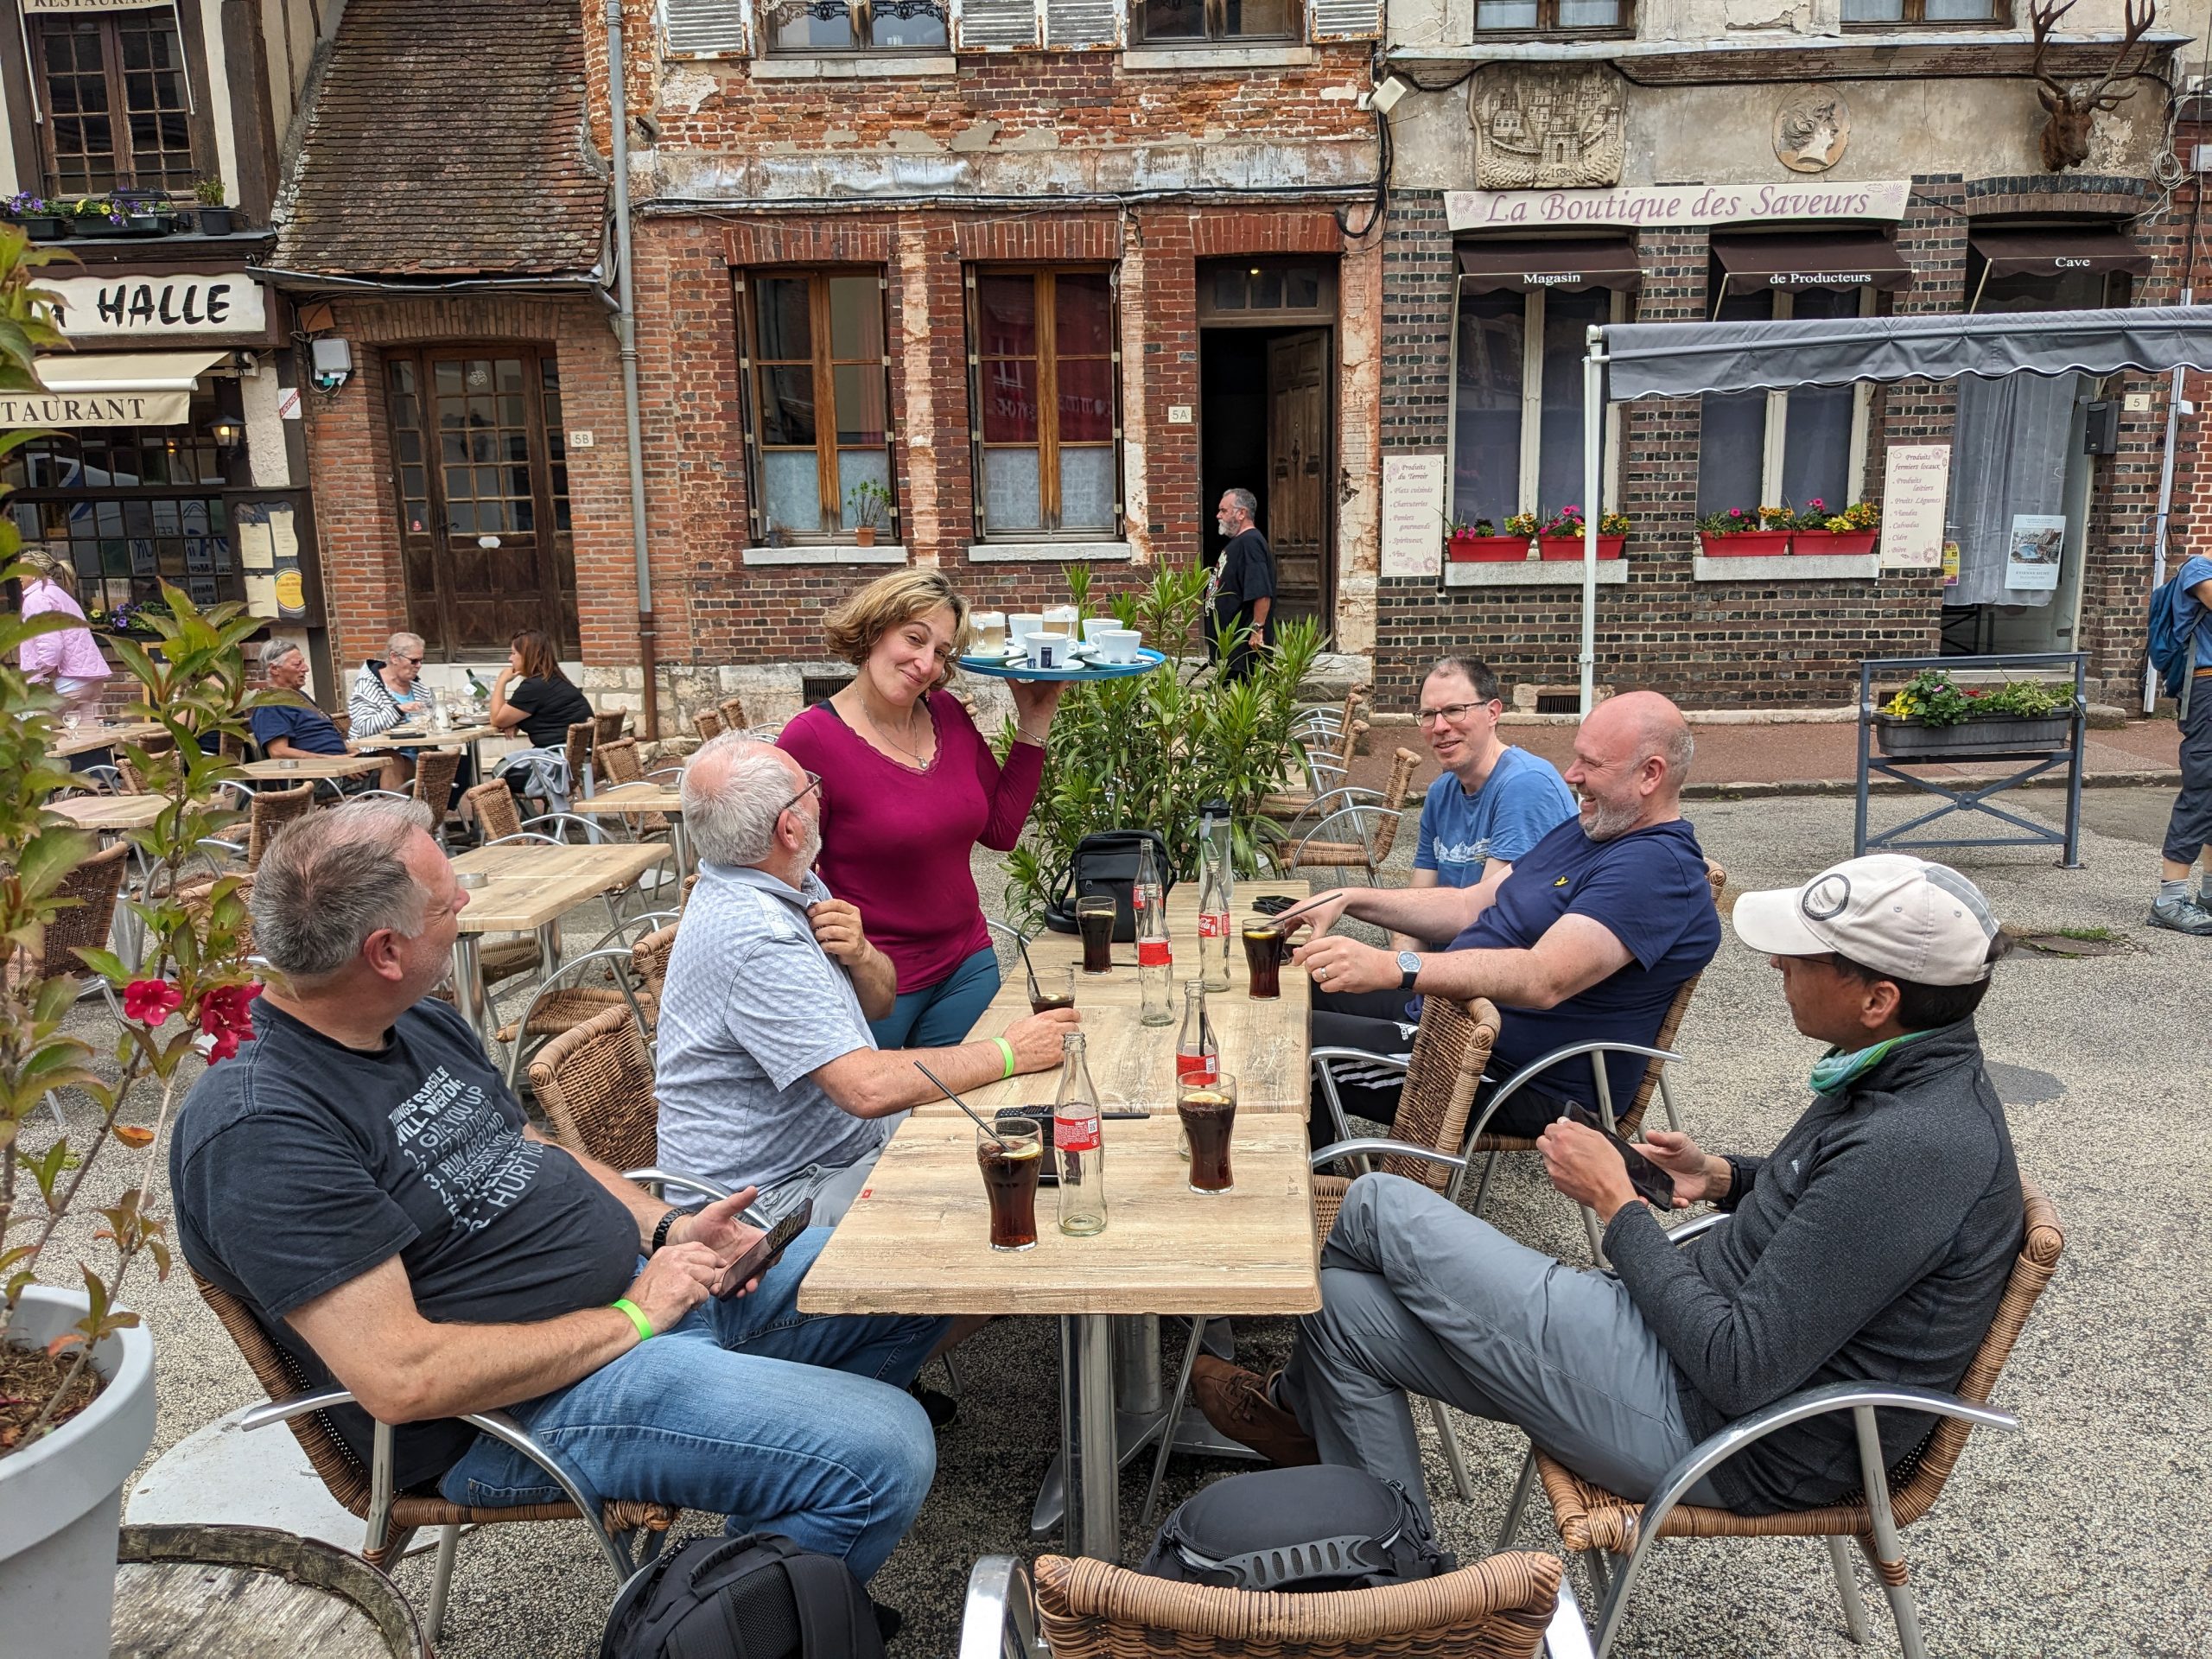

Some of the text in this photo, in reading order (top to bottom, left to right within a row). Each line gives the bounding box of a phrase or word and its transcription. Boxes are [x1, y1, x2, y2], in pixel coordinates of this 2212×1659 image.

[1485, 185, 1870, 224] La Boutique des Saveurs
[2055, 257, 2091, 267] Cave
[1522, 273, 1581, 286] Magasin
[1770, 272, 1872, 284] de Producteurs
[97, 283, 232, 327] HALLE
[2133, 398, 2140, 407] 5
[1172, 410, 1188, 420] 5A
[575, 434, 589, 444] 5B
[464, 1086, 486, 1105] UP
[437, 1149, 467, 1179] RUN
[465, 1112, 505, 1163] AROUND
